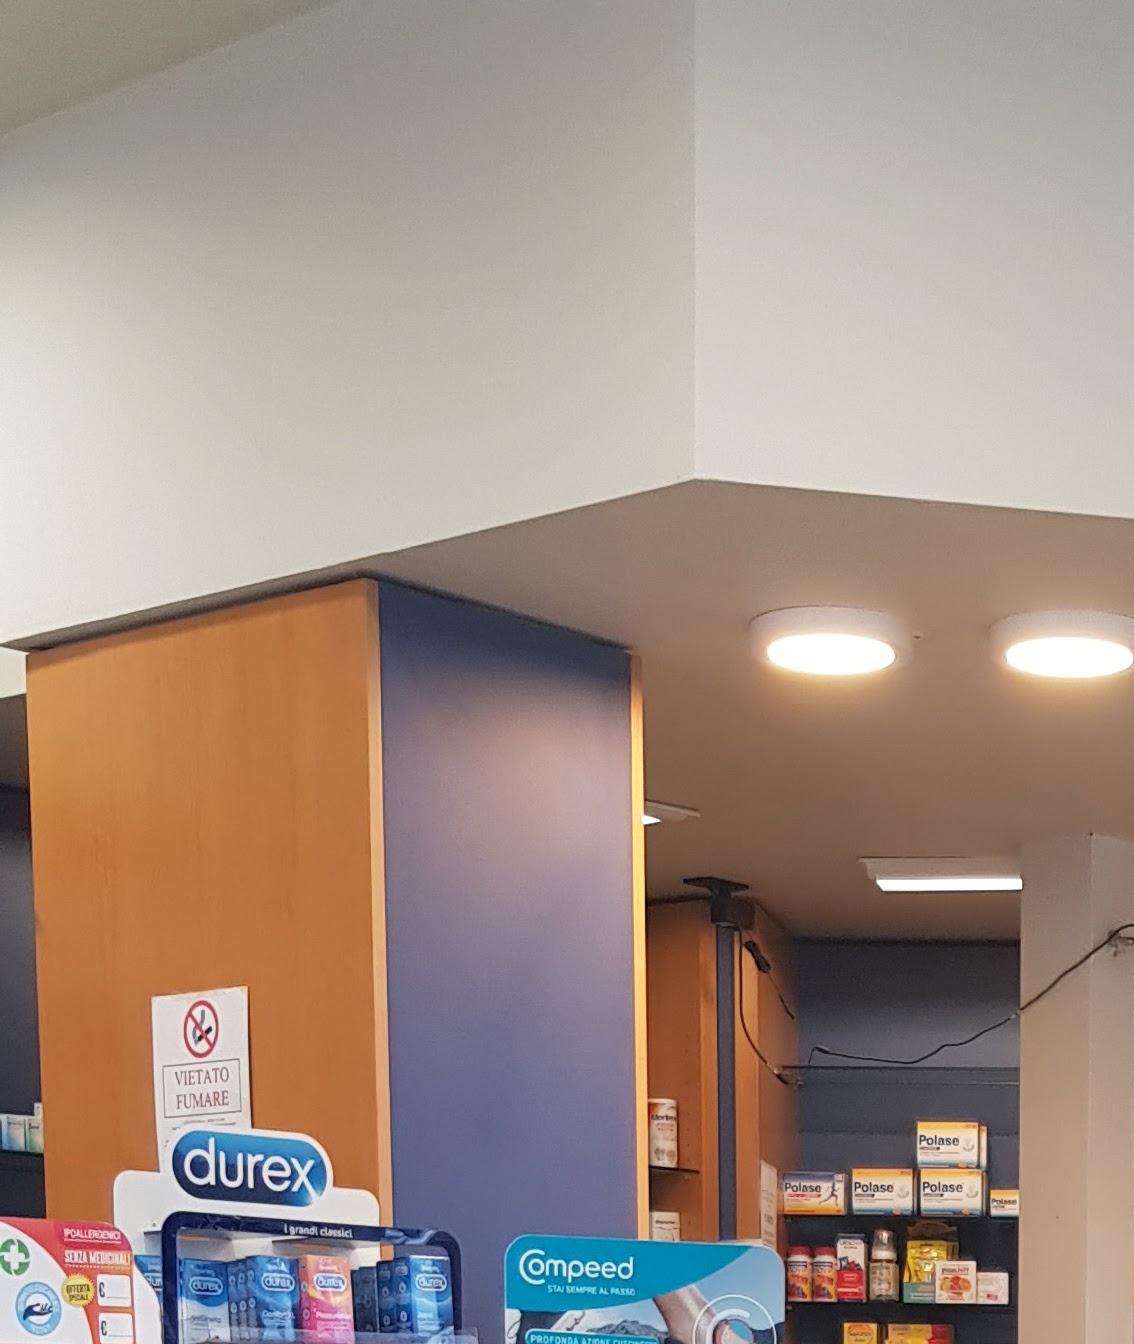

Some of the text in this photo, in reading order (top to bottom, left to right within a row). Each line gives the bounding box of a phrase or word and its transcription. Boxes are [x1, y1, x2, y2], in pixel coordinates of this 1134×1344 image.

[174, 1066, 230, 1087] VIETATO
[175, 1090, 230, 1110] FUMARE
[918, 1134, 960, 1147] Polase
[183, 1137, 316, 1199] durex
[784, 1182, 822, 1193] Polase
[853, 1181, 894, 1193] Polase
[922, 1181, 963, 1193] Polase
[289, 1225, 353, 1238] grandi classici
[519, 1248, 633, 1285] Compeed
[566, 1286, 597, 1296] SEMPRE
[599, 1287, 609, 1296] AL
[610, 1288, 636, 1297] PASSO
